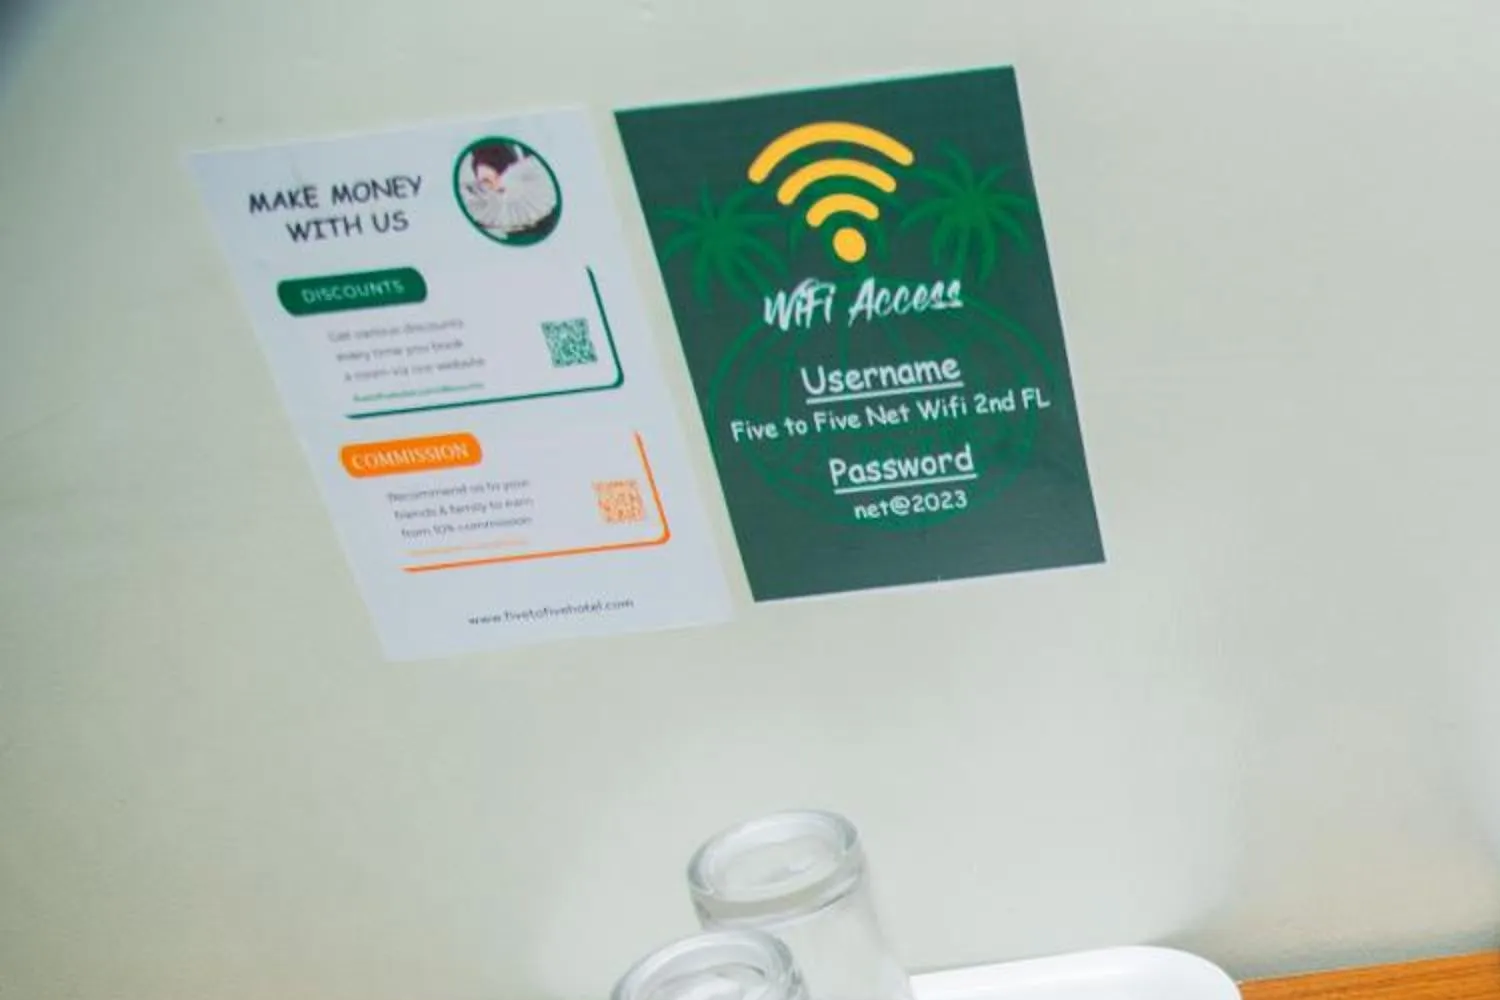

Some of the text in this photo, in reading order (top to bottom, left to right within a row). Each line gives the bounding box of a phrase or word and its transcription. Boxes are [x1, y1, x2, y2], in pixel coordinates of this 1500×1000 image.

[249, 176, 421, 213] MAKE MONEY
[286, 210, 409, 242] WITH US
[301, 280, 405, 304] DISCOUNTS
[763, 277, 963, 332] WiFi Access
[800, 356, 963, 400] Username
[730, 387, 1051, 443] Five to Five Net Wifi 2nd FL
[351, 441, 471, 470] COMMISSION
[828, 443, 976, 488] Password
[854, 489, 968, 521] net@2023
[468, 597, 635, 625] www.fivetofivehotel.com
